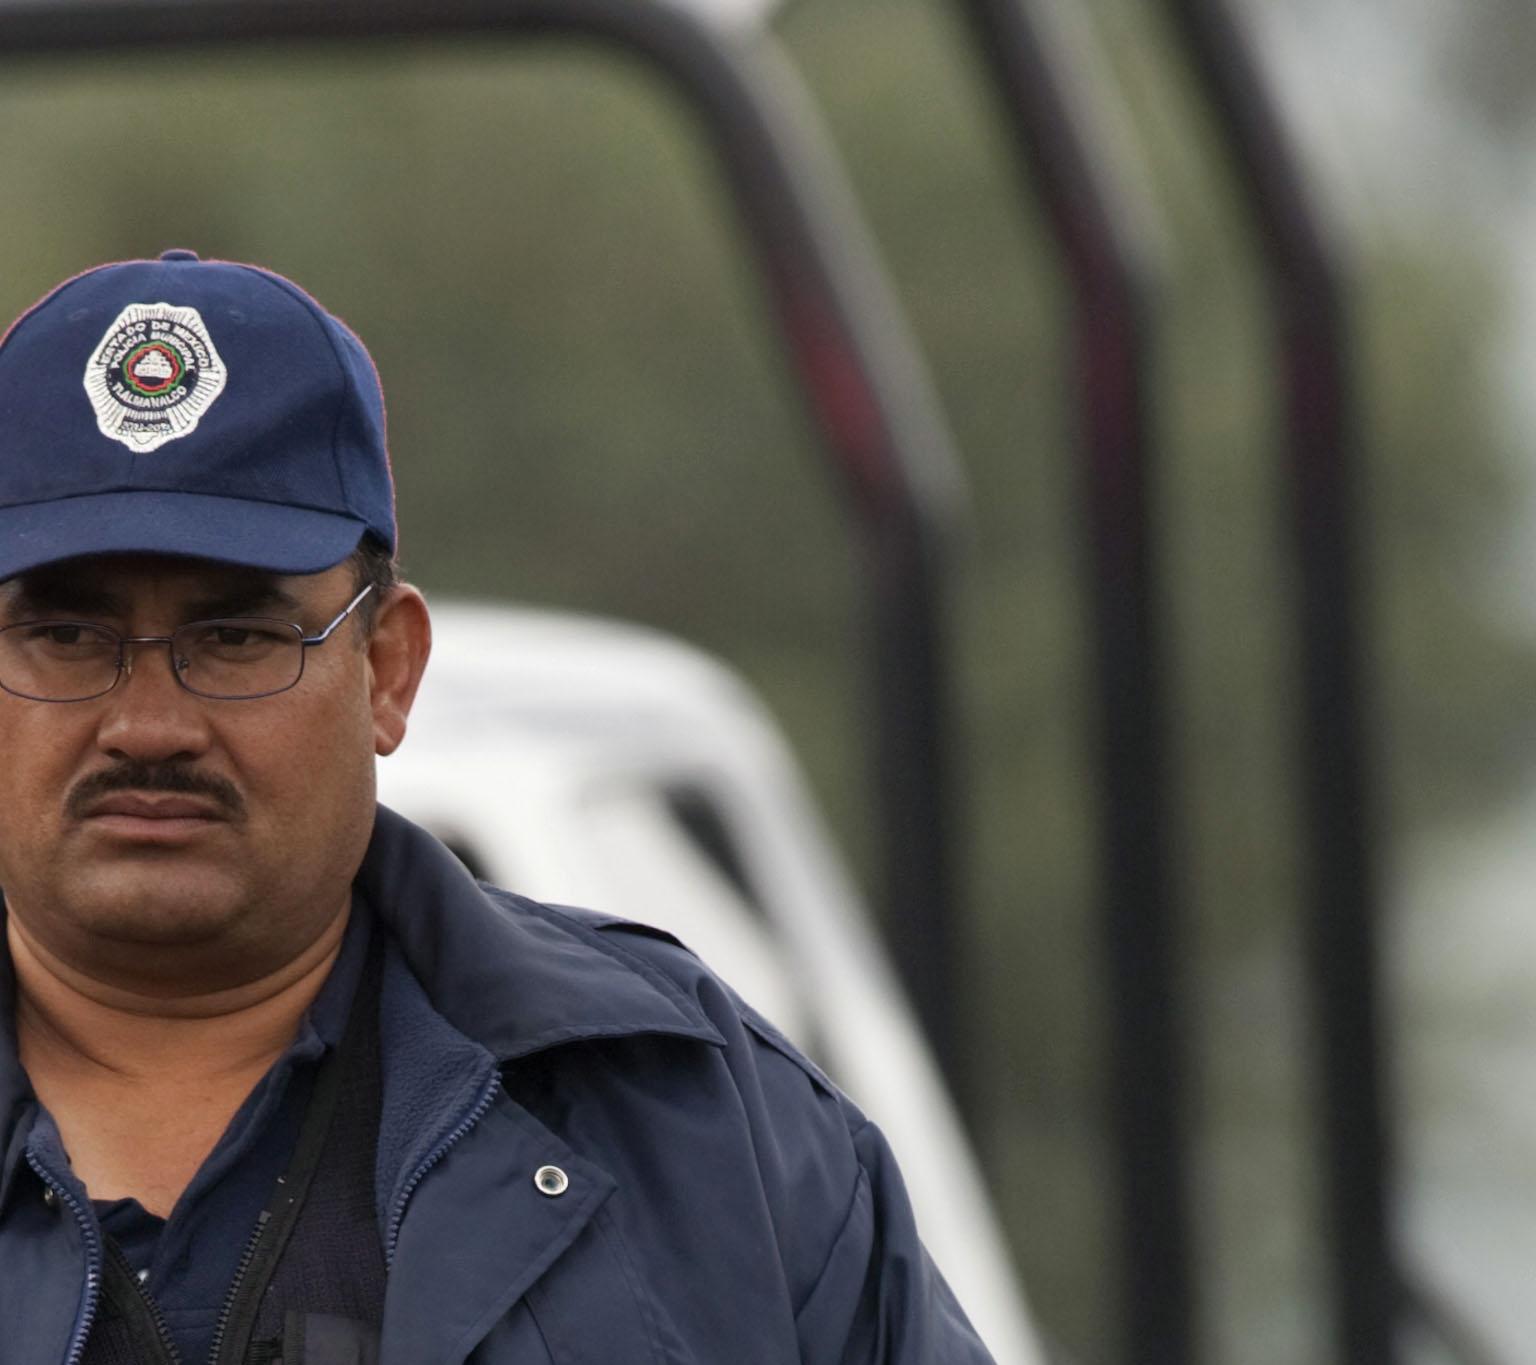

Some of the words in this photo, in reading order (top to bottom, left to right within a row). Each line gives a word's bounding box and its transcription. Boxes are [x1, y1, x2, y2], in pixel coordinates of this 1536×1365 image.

[99, 322, 146, 365] ESTADO
[151, 320, 170, 331] DE
[150, 331, 196, 371] MUNICIPAL
[112, 381, 187, 408] TLALMANALCO
